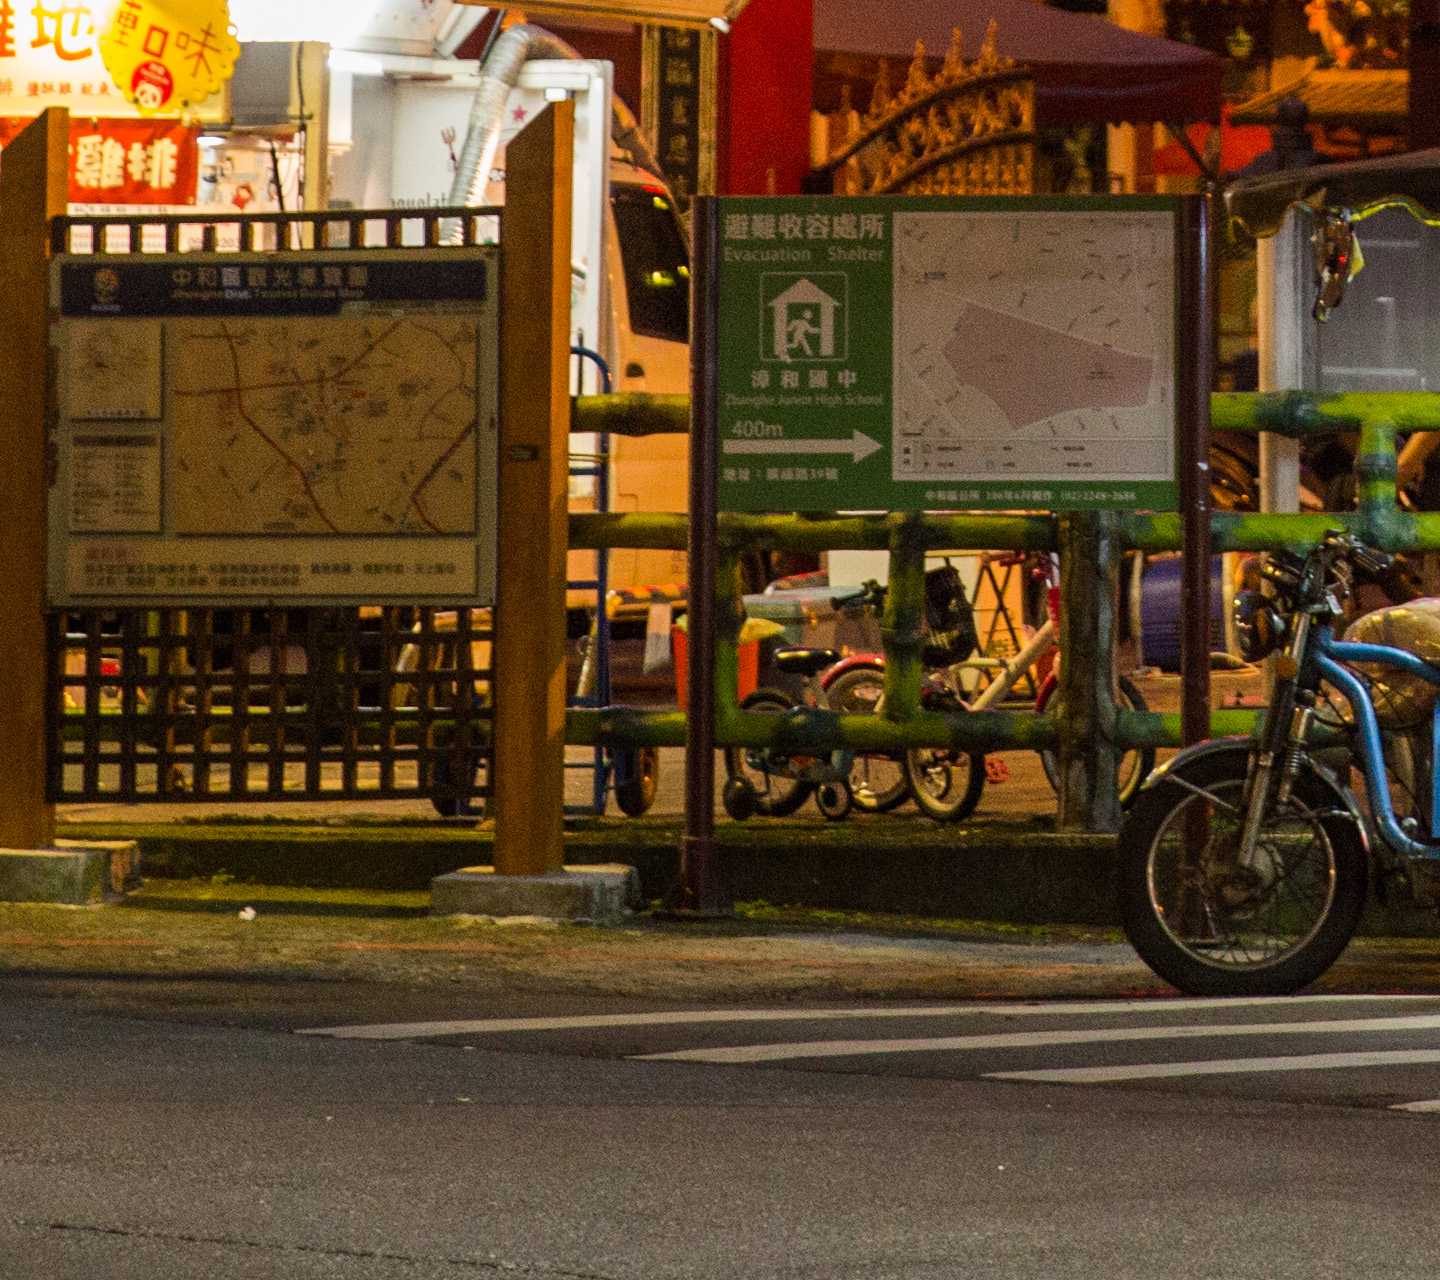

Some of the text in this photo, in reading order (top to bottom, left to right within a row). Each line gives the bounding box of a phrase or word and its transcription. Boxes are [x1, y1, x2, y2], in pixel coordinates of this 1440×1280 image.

[68, 134, 179, 191] 雞排
[724, 213, 886, 240] 避難收容處所
[731, 419, 784, 438] 400m
